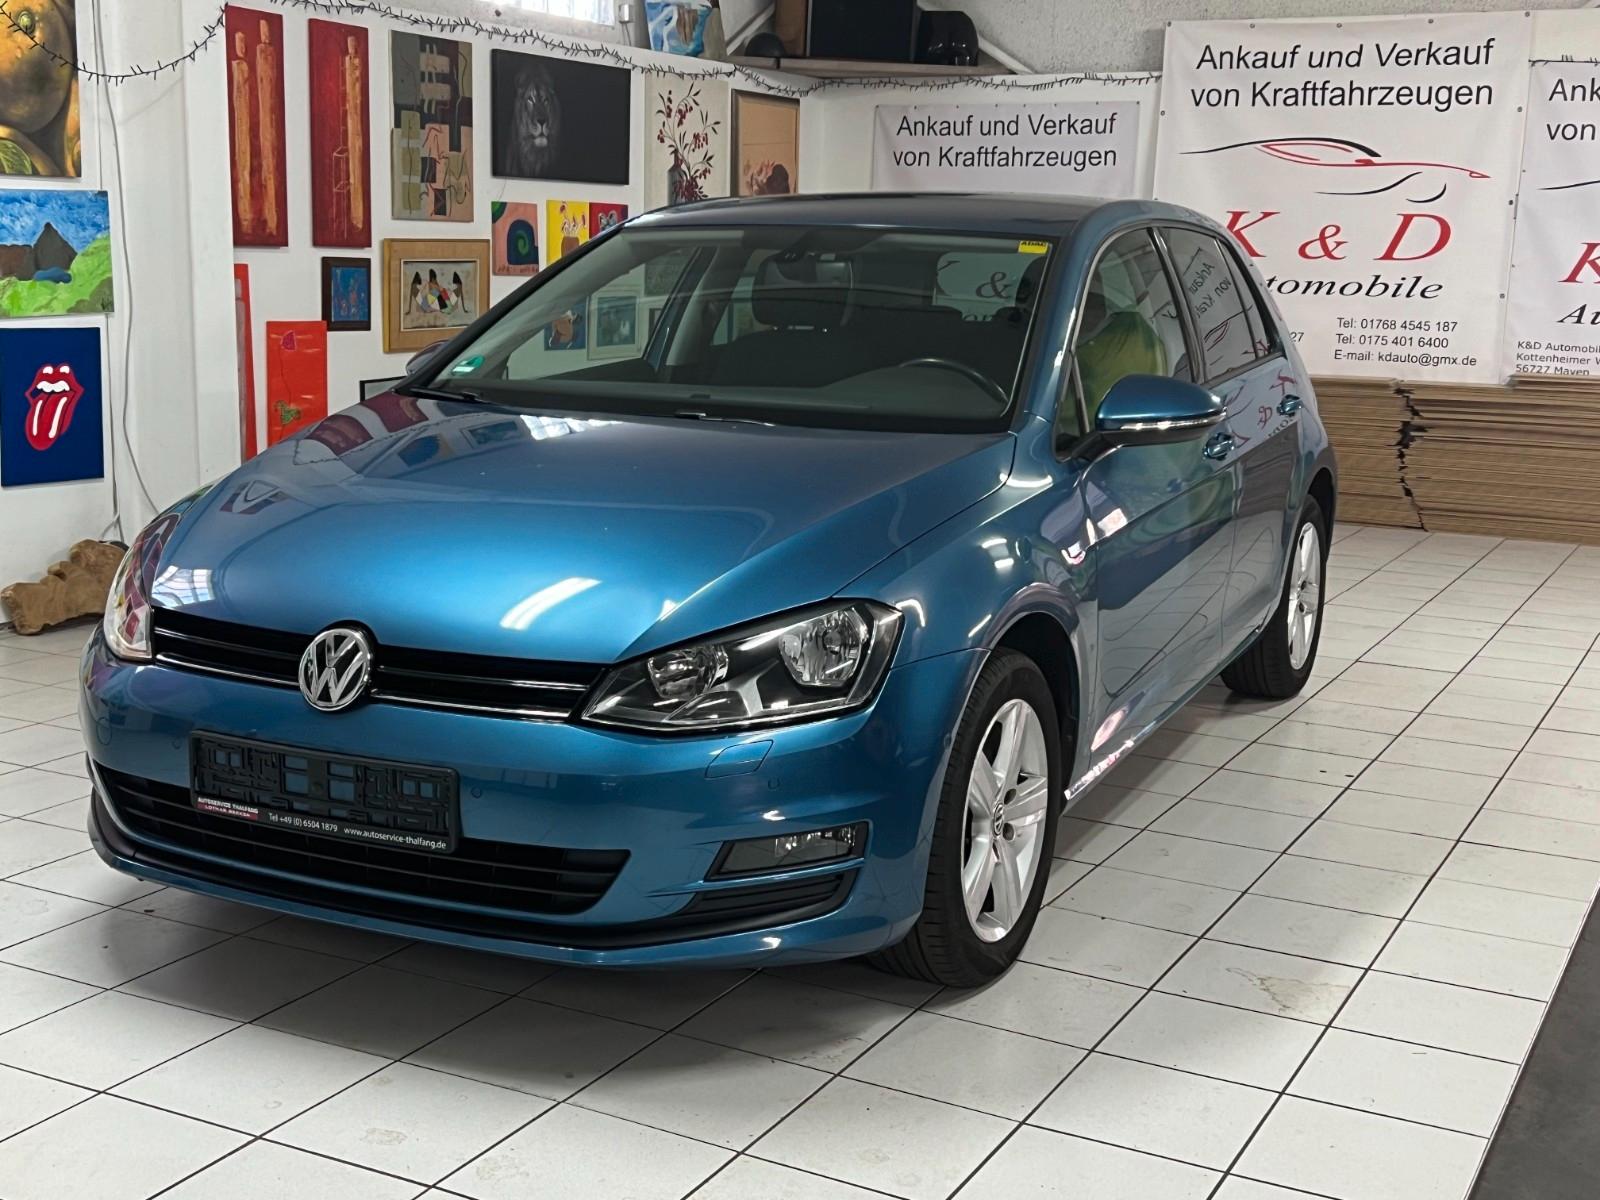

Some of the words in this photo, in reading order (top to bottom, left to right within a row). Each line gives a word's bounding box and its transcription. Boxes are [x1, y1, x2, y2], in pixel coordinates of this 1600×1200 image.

[1196, 44, 1301, 70] Ankauf
[1308, 43, 1363, 68] und
[1375, 38, 1495, 67] Verkauf
[1191, 87, 1240, 107] von
[1251, 80, 1493, 112] Kraftfahrzeugen
[896, 115, 974, 136] Ankauf
[980, 115, 1019, 136] und
[1028, 112, 1118, 135] Verkauf
[1546, 123, 1596, 141] von
[893, 151, 930, 167] von
[938, 146, 1117, 171] Kraftfahrzeugen
[1298, 224, 1349, 260] &
[1373, 213, 1451, 261] D
[1336, 317, 1357, 329] Tel:
[1360, 319, 1397, 330] 01768
[1400, 320, 1431, 332] 4545
[1436, 321, 1458, 332] 187
[1336, 334, 1355, 345] Tel:
[1359, 335, 1388, 346] 0175
[1392, 336, 1413, 347] 401
[1417, 337, 1449, 348] 6400
[1517, 341, 1542, 350] K&D
[1334, 350, 1374, 362] E-mail:
[1378, 351, 1477, 367] kdauto@gmx.de
[1516, 353, 1591, 365] Kottenheimer
[1515, 364, 1551, 374] 56727
[268, 812, 278, 822] Tel
[279, 816, 292, 825] +49
[293, 817, 303, 827] (0)
[303, 820, 320, 830] 6504
[321, 822, 338, 832] 1879
[343, 827, 447, 849] www.autoservice-thalfang.de
